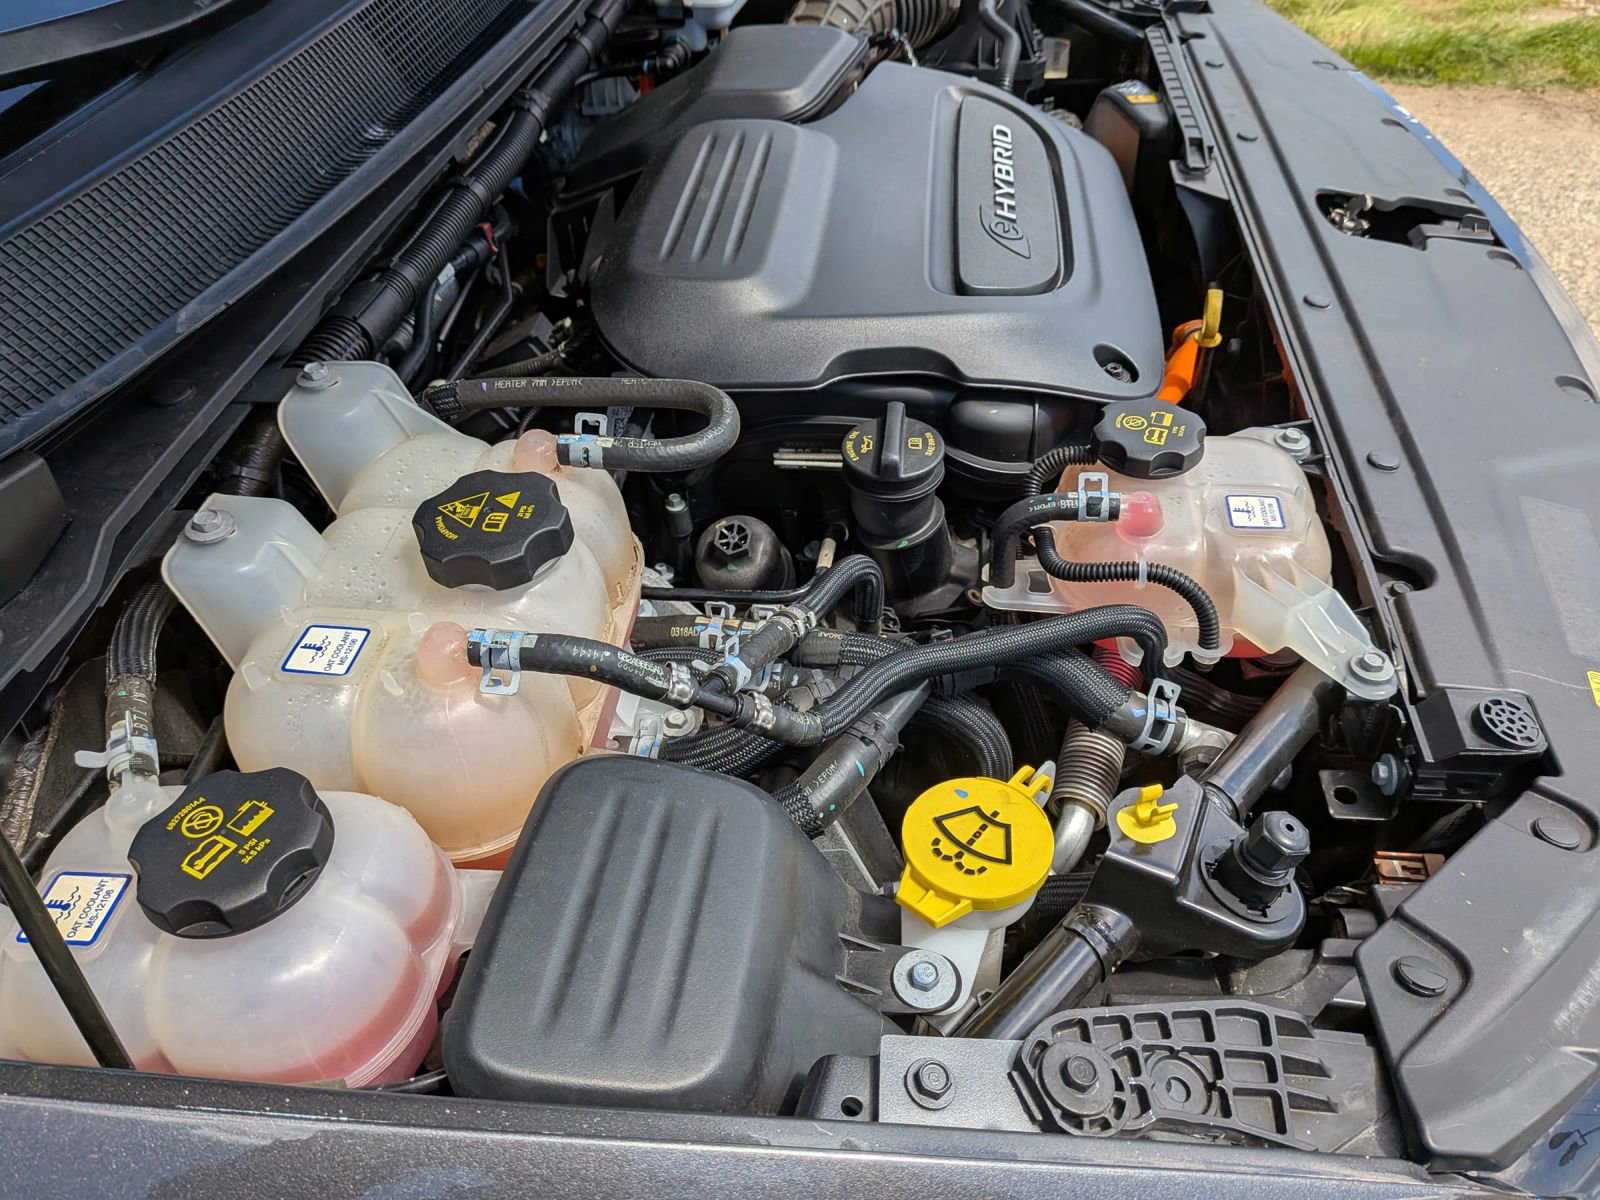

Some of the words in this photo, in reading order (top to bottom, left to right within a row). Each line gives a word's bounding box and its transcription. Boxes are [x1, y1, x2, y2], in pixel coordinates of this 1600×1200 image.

[848, 430, 860, 439] OIL
[845, 440, 860, 461] ENGINE
[323, 659, 335, 672] OAT
[331, 631, 352, 659] COOLANT
[246, 838, 258, 850] PSI
[66, 922, 83, 938] OAT
[80, 879, 109, 919] COOLANT
[84, 889, 114, 929] MS-12106
